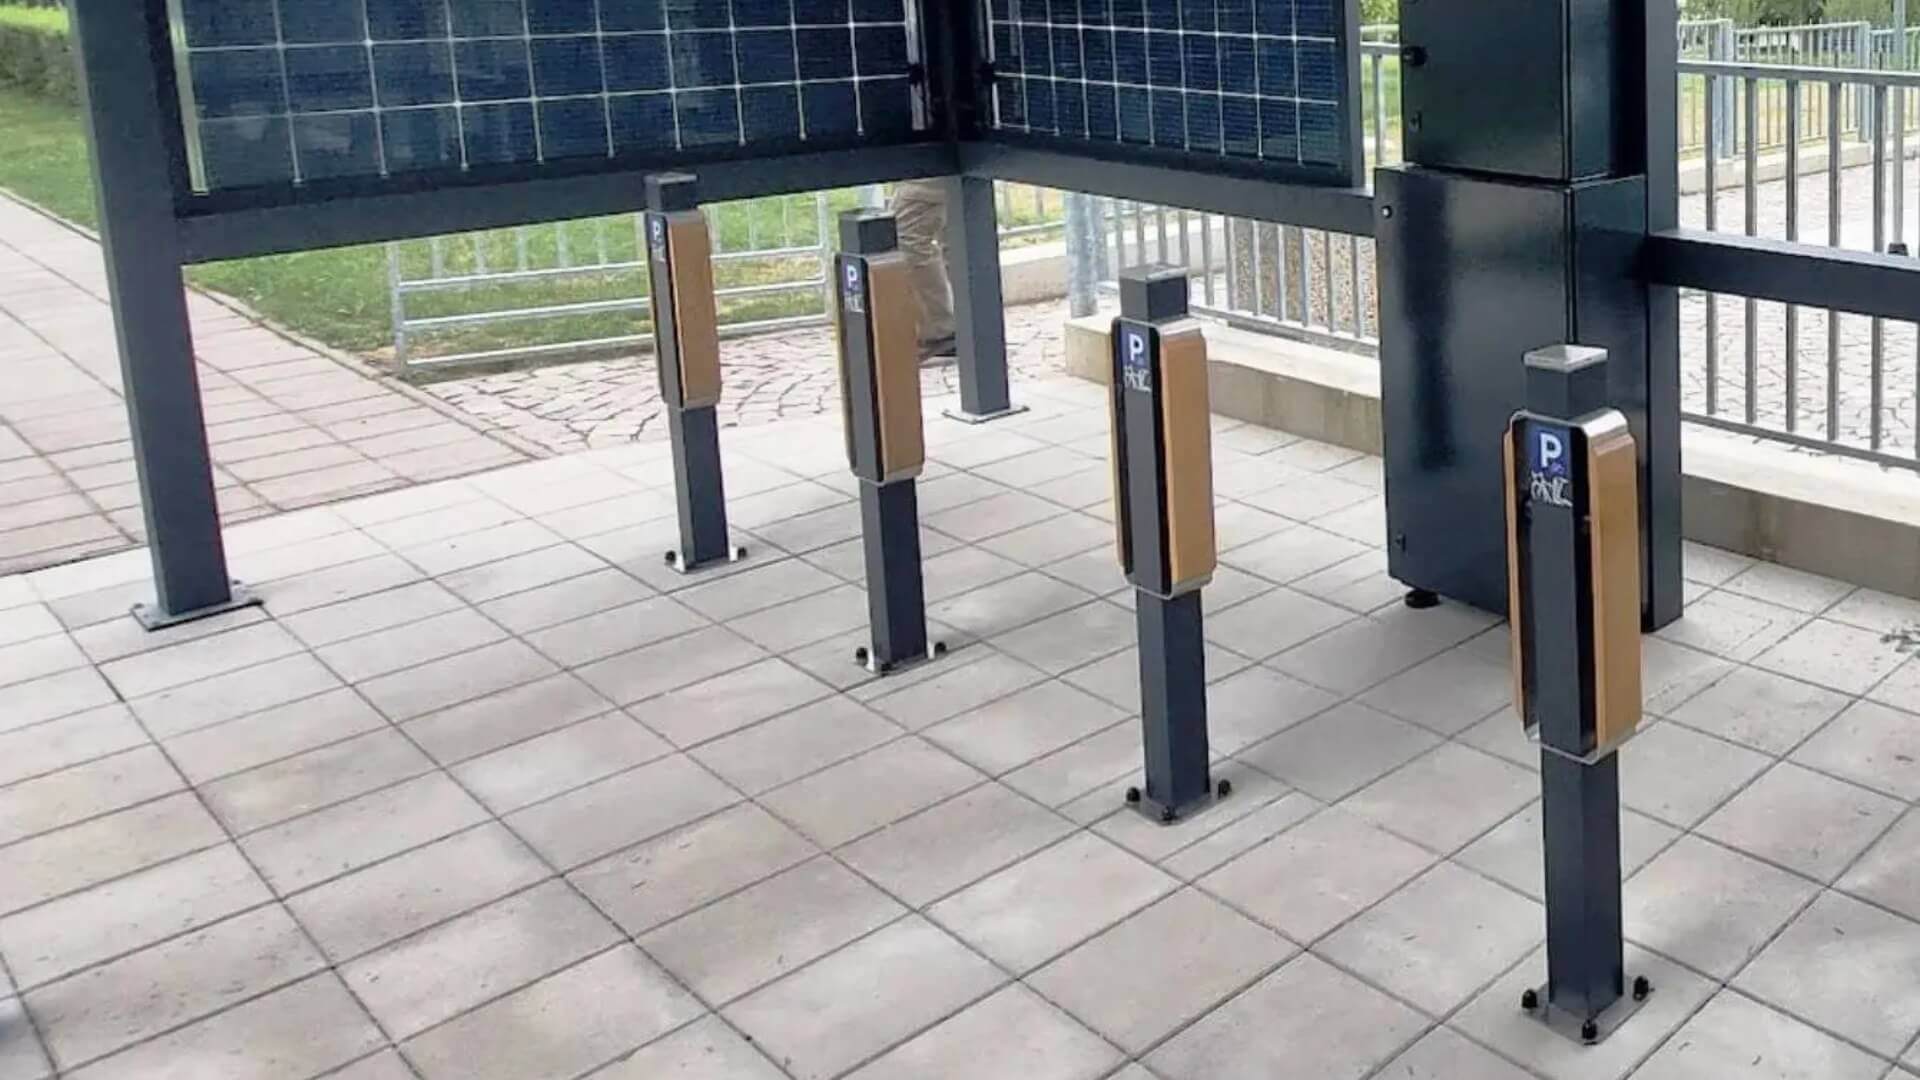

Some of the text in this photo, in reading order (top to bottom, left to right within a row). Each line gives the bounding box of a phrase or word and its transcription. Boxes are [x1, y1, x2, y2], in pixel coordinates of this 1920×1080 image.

[847, 265, 857, 288] P
[1129, 333, 1143, 361] P
[1540, 432, 1562, 467] P
